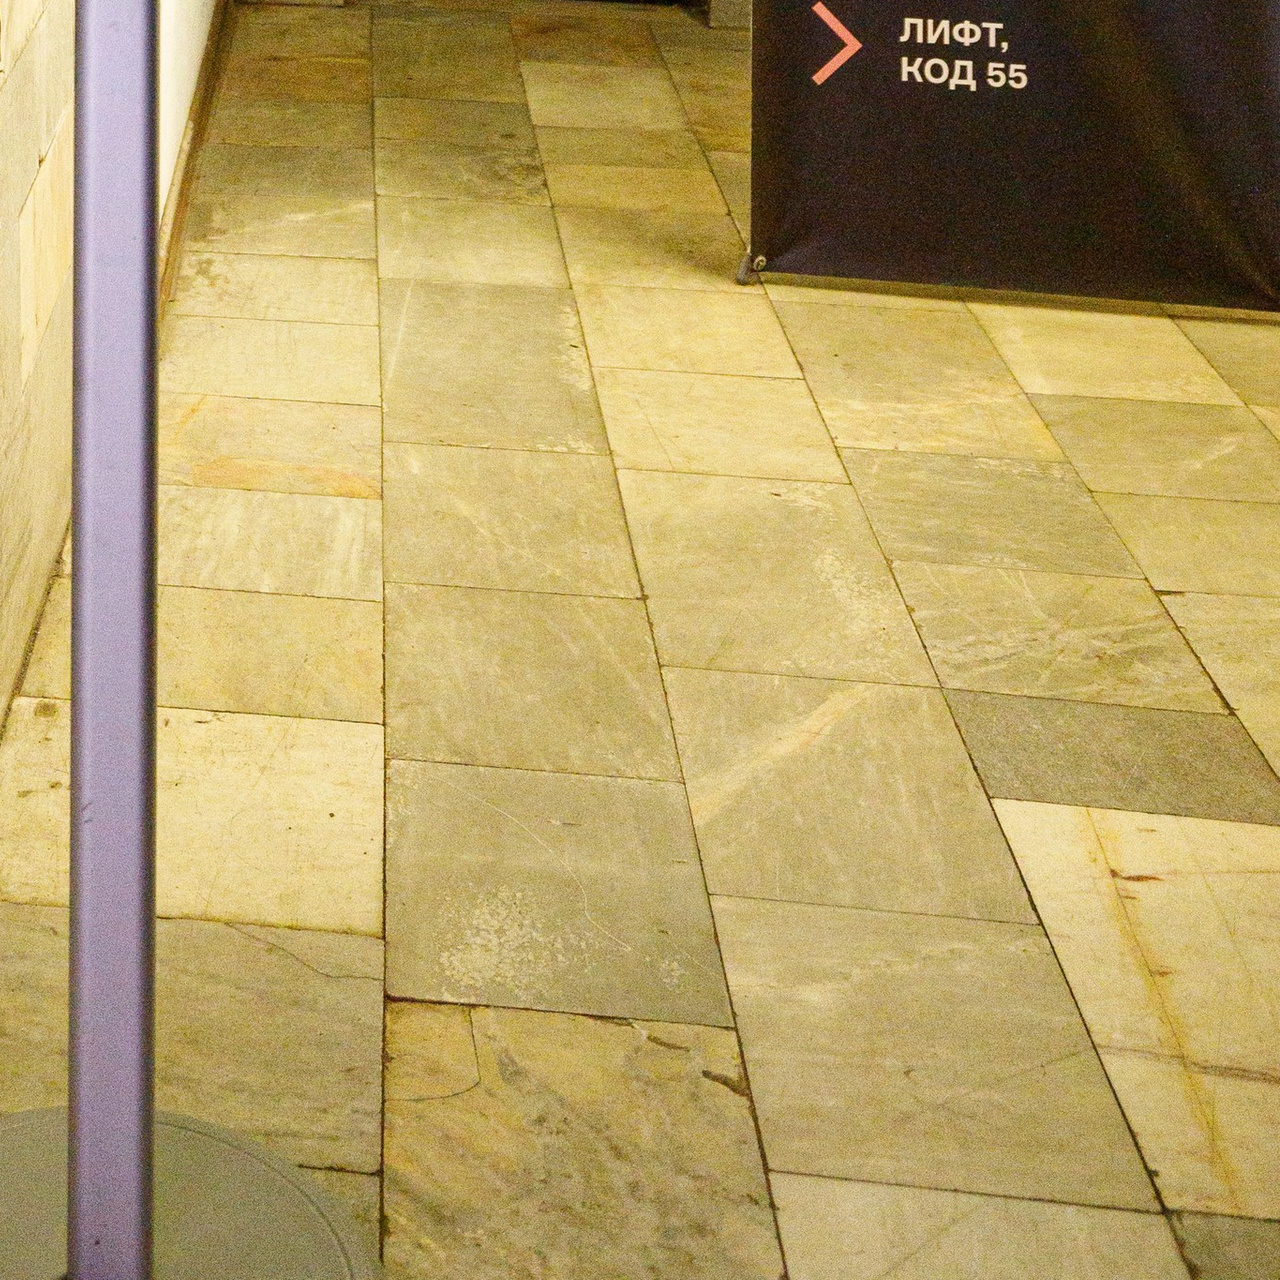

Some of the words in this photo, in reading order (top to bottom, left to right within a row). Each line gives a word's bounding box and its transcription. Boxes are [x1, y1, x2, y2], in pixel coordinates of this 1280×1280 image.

[900, 17, 1010, 53] ЛИФТ,
[900, 56, 978, 93] КОД
[986, 61, 1029, 90] 55
